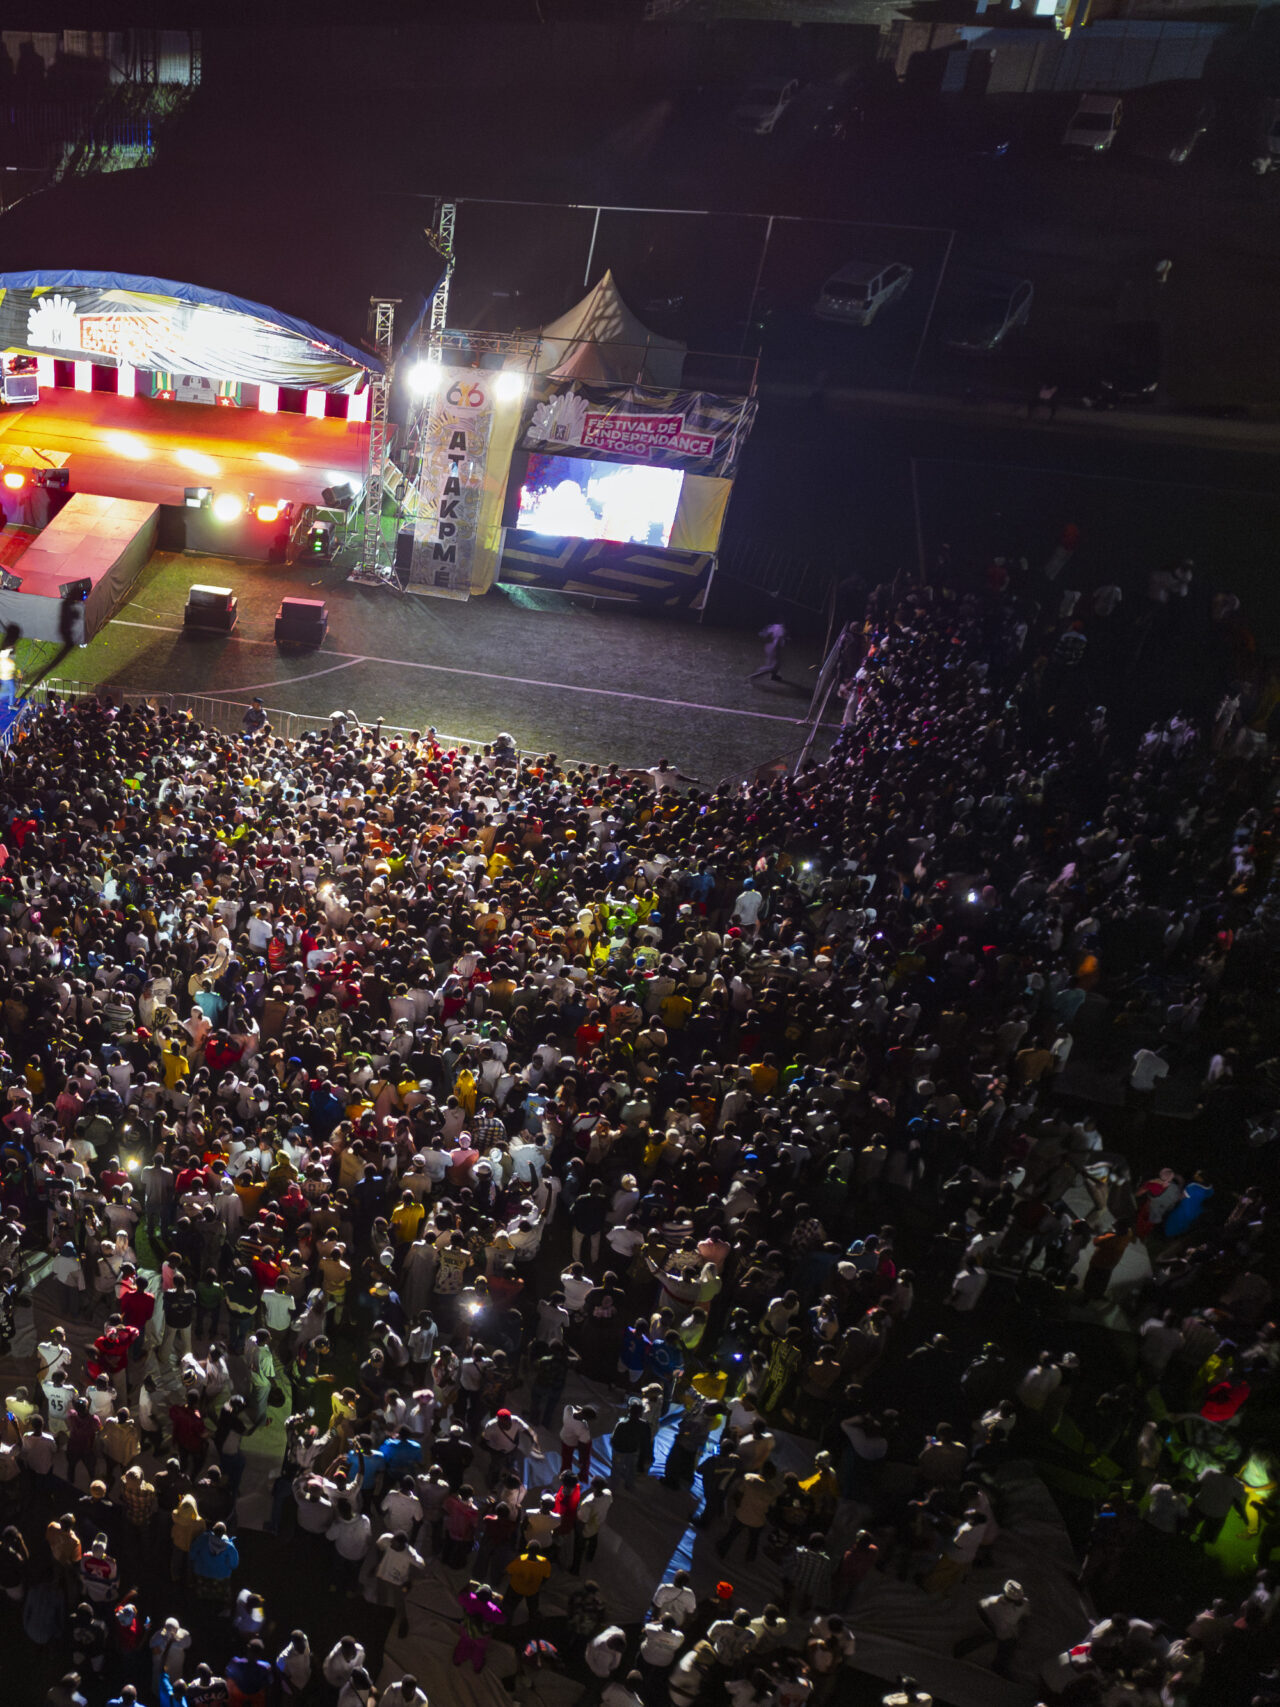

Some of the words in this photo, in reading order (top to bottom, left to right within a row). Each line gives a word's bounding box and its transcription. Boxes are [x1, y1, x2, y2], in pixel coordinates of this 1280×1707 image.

[588, 418, 655, 433] FESTIVAL
[584, 435, 605, 447] DU
[607, 440, 647, 454] TOGO
[50, 1399, 64, 1412] 45
